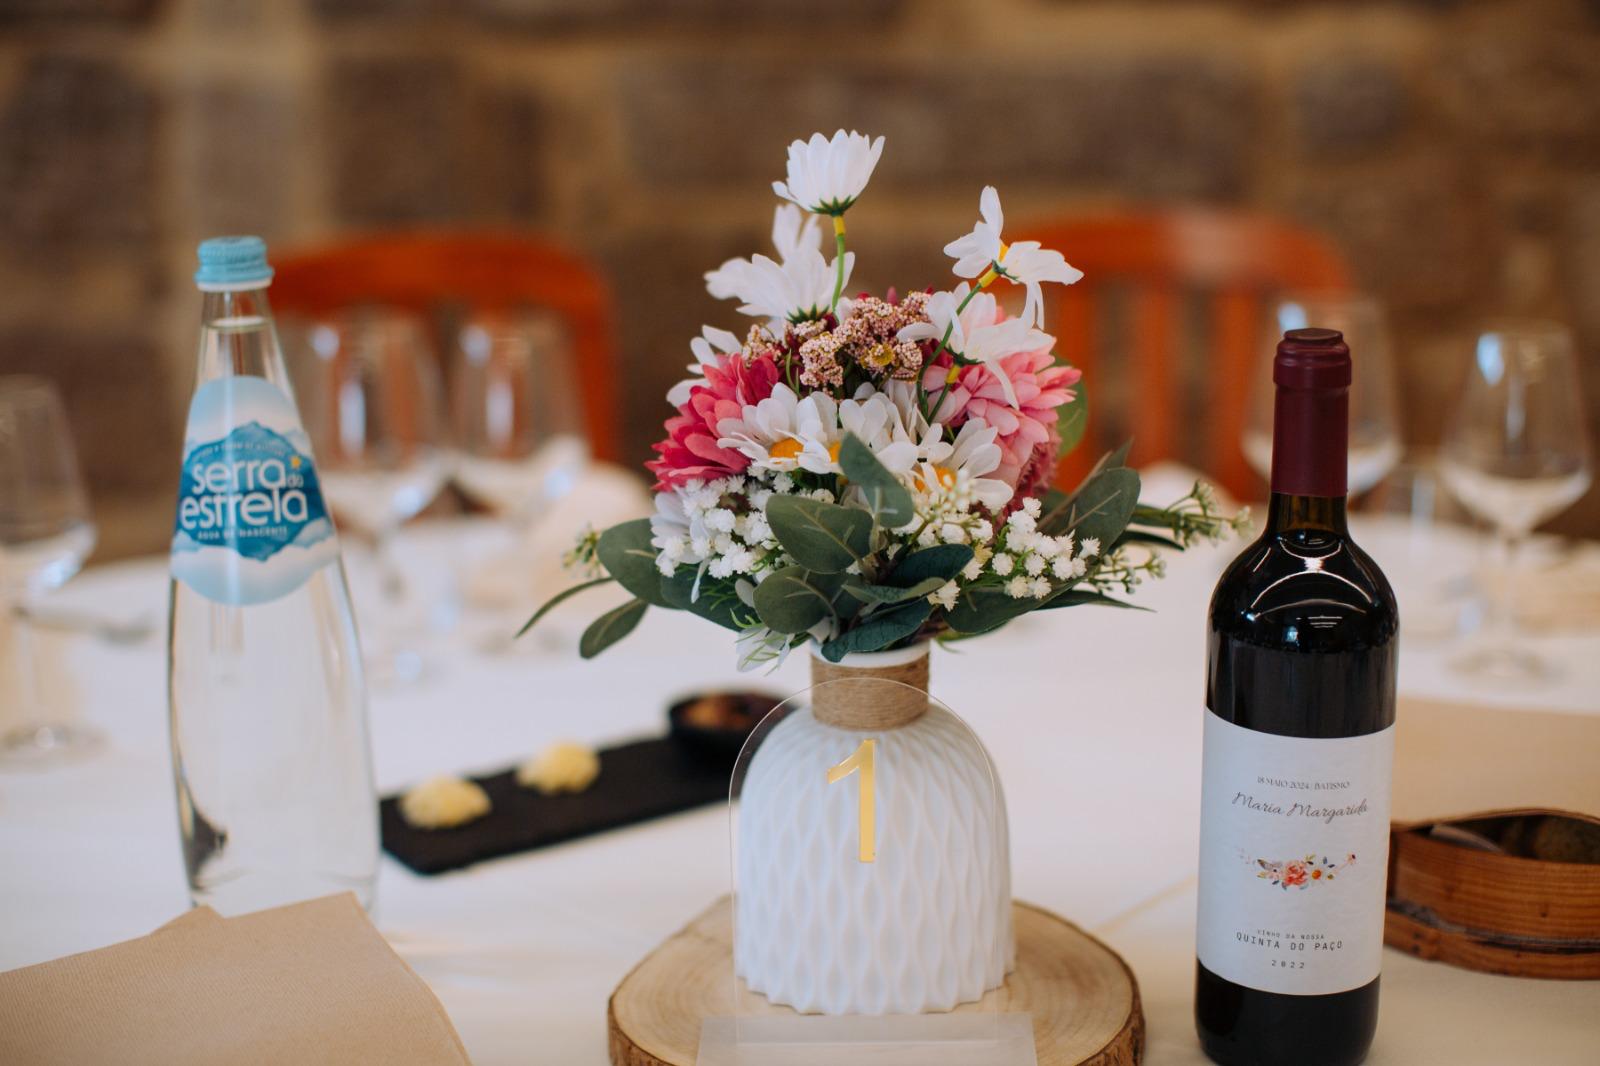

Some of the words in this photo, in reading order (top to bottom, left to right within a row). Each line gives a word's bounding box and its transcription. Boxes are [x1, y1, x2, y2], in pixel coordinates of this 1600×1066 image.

[191, 458, 286, 495] serra
[180, 488, 308, 530] estrela
[826, 739, 876, 863] 1
[1232, 791, 1283, 814] Maria
[1286, 798, 1369, 825] Margarida
[1236, 931, 1280, 949] QUINTA
[1290, 942, 1305, 951] DO
[1314, 940, 1343, 951] PAÇO
[1271, 959, 1305, 969] 2022
